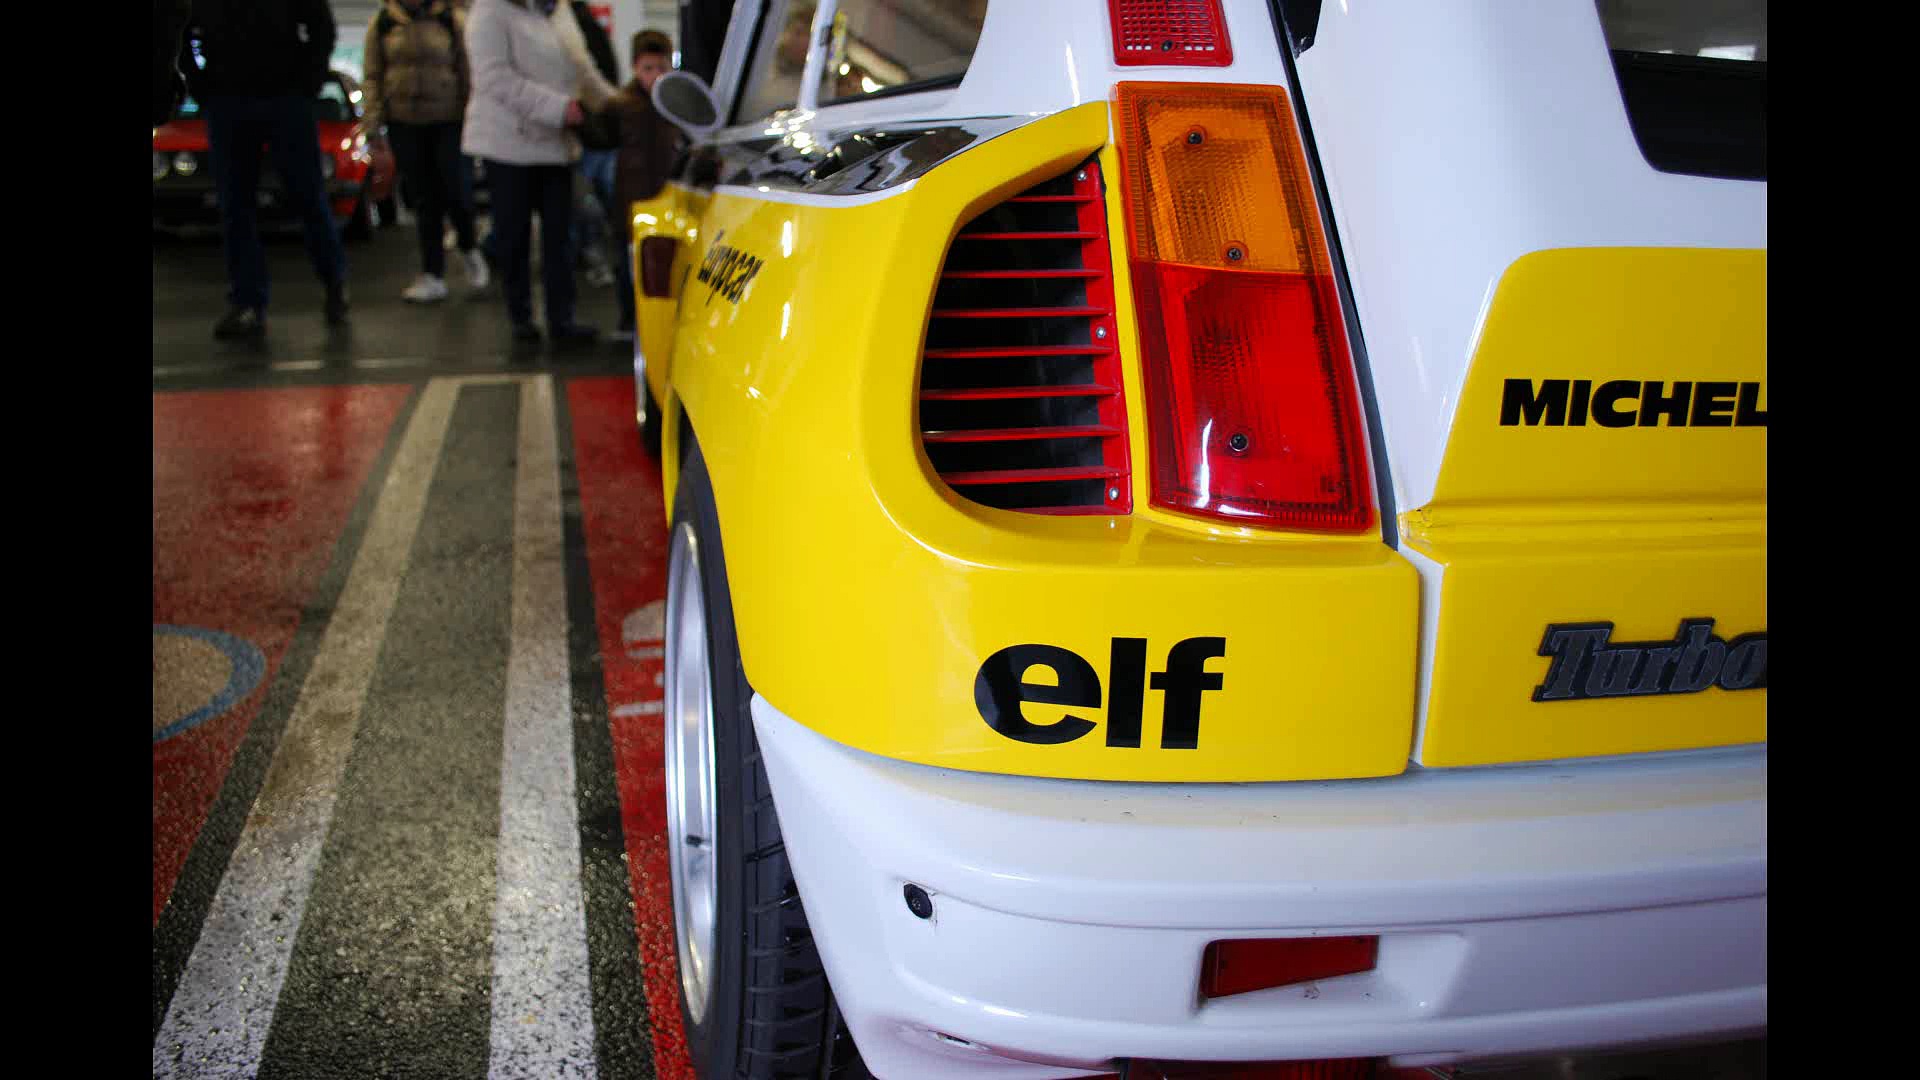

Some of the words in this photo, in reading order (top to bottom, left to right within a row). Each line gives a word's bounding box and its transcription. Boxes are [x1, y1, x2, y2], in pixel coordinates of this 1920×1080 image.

[1499, 379, 1767, 428] MICHEL
[974, 636, 1226, 750] elf
[1531, 617, 1767, 702] Turbo
